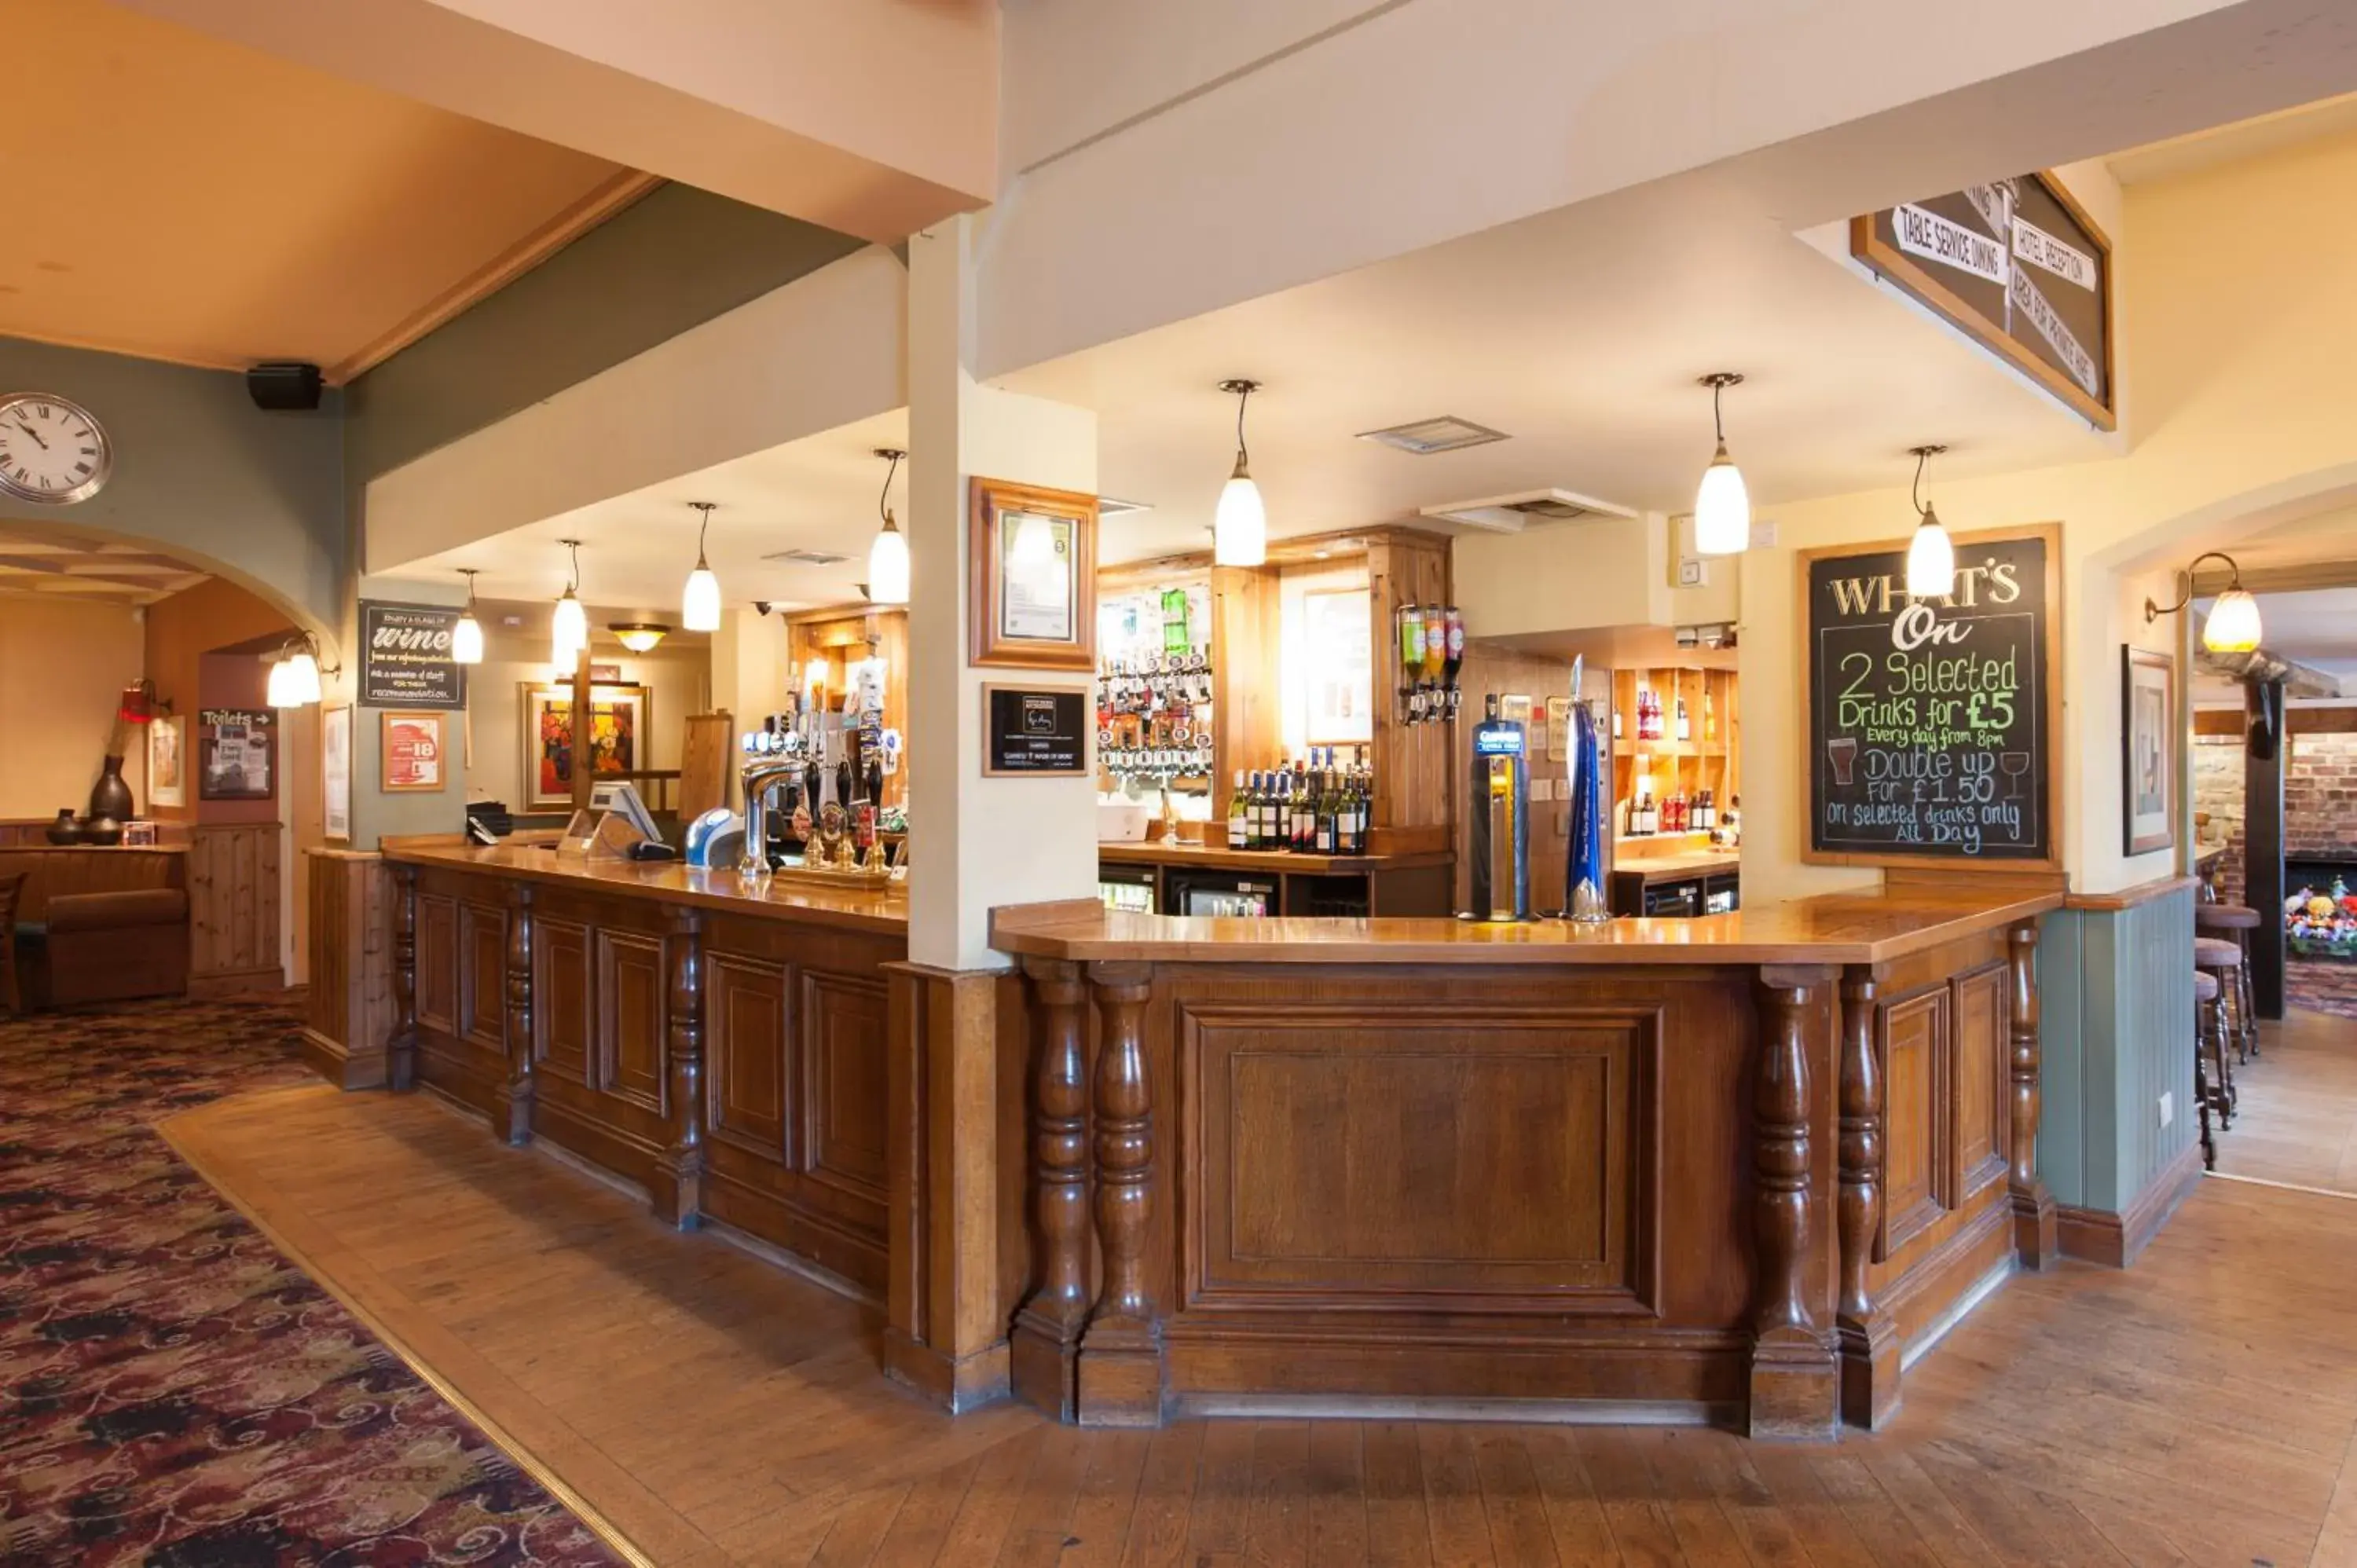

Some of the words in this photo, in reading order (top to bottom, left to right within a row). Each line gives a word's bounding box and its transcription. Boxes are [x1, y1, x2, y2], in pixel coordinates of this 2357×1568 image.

[1900, 206, 1932, 249] TABLE
[1934, 221, 1970, 265] SERVICE
[1971, 237, 1999, 276] DINING
[2018, 225, 2043, 262] HOTEL
[2045, 240, 2082, 280] RECEPTION
[372, 626, 451, 650] wine
[1891, 603, 1973, 651] On
[1838, 652, 1875, 699] 2
[1886, 643, 2020, 695] Selected
[202, 709, 252, 725] Toilets
[1839, 697, 1916, 727] Drinks
[1925, 698, 1963, 731] for
[1967, 691, 2014, 729] £5
[1867, 727, 1908, 748] Every
[1912, 727, 1937, 753] day
[1939, 727, 1972, 750] from
[1977, 729, 2005, 749] 8pm
[1864, 744, 1952, 780] Double
[1962, 752, 1996, 786] up
[1867, 780, 1902, 802] For
[1912, 775, 1995, 803] £1.50
[1853, 802, 1917, 826] selected
[1924, 804, 1976, 824] drinks
[1981, 800, 2020, 840] only
[1895, 824, 1923, 843] All
[1931, 822, 1980, 854] Day
